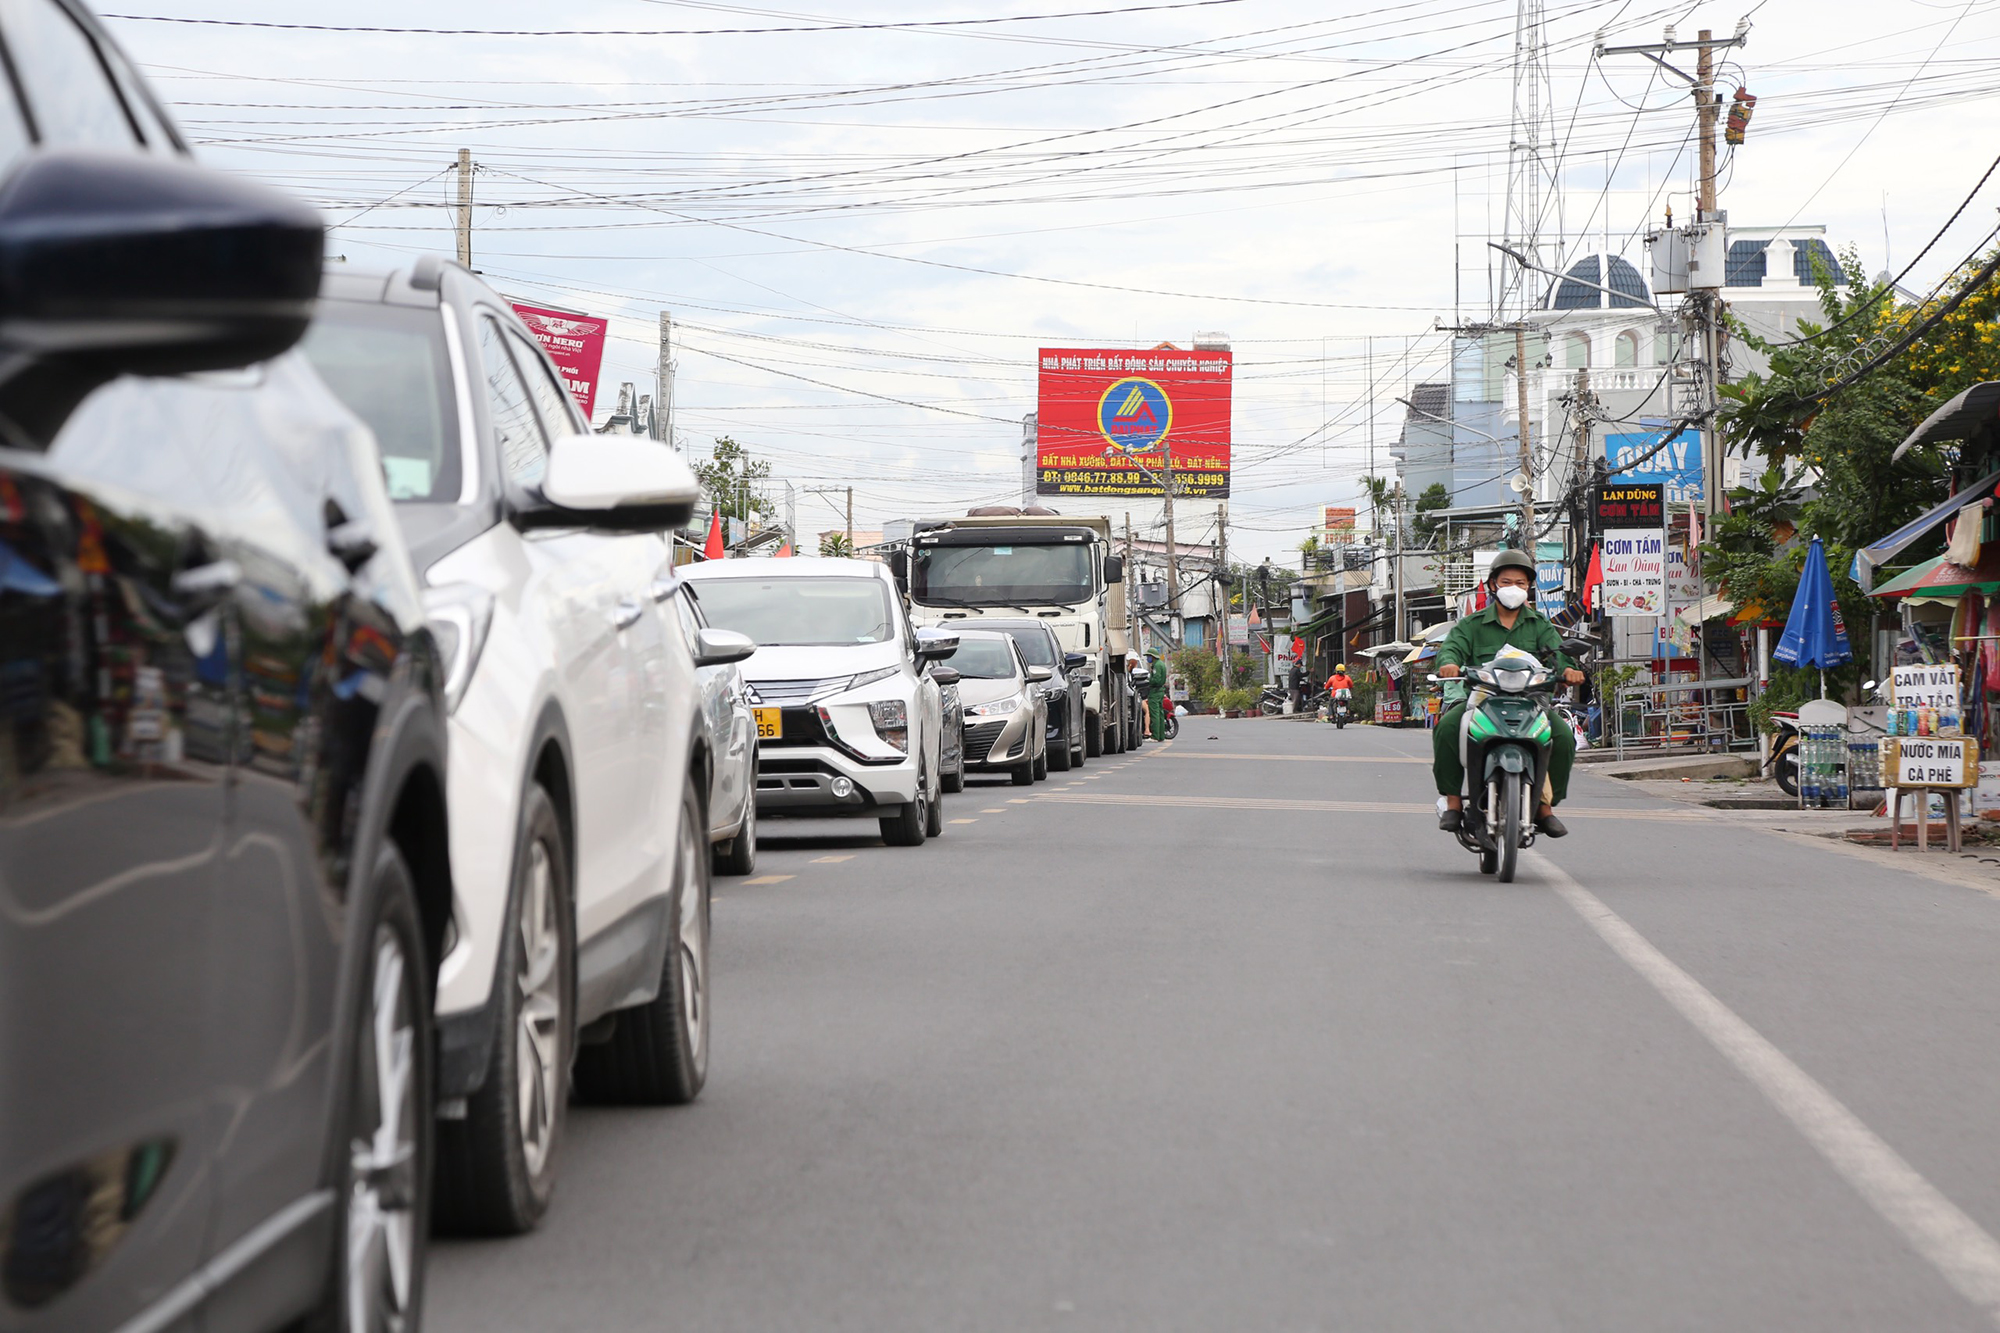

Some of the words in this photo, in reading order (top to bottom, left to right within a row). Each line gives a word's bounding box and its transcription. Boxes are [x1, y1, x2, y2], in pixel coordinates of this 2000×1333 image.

[552, 337, 584, 348] NERO
[1061, 355, 1082, 370] PHÁT
[1044, 470, 1061, 482] ĐT:
[1064, 472, 1140, 484] 0846.77.88.99
[1602, 490, 1624, 500] LAN
[1626, 488, 1656, 500] DŨNG
[1600, 502, 1626, 517] CƠM
[1630, 500, 1660, 516] TẤM
[1606, 538, 1632, 555] CƠM
[1636, 534, 1661, 554] TẤM
[1606, 557, 1628, 572] Lan
[1894, 673, 1926, 687] CAM
[1900, 743, 1934, 759] NƯỚC
[1938, 744, 1962, 759] MÍA
[1908, 765, 1924, 782] CÀ
[1928, 766, 1952, 782] PHÊ
